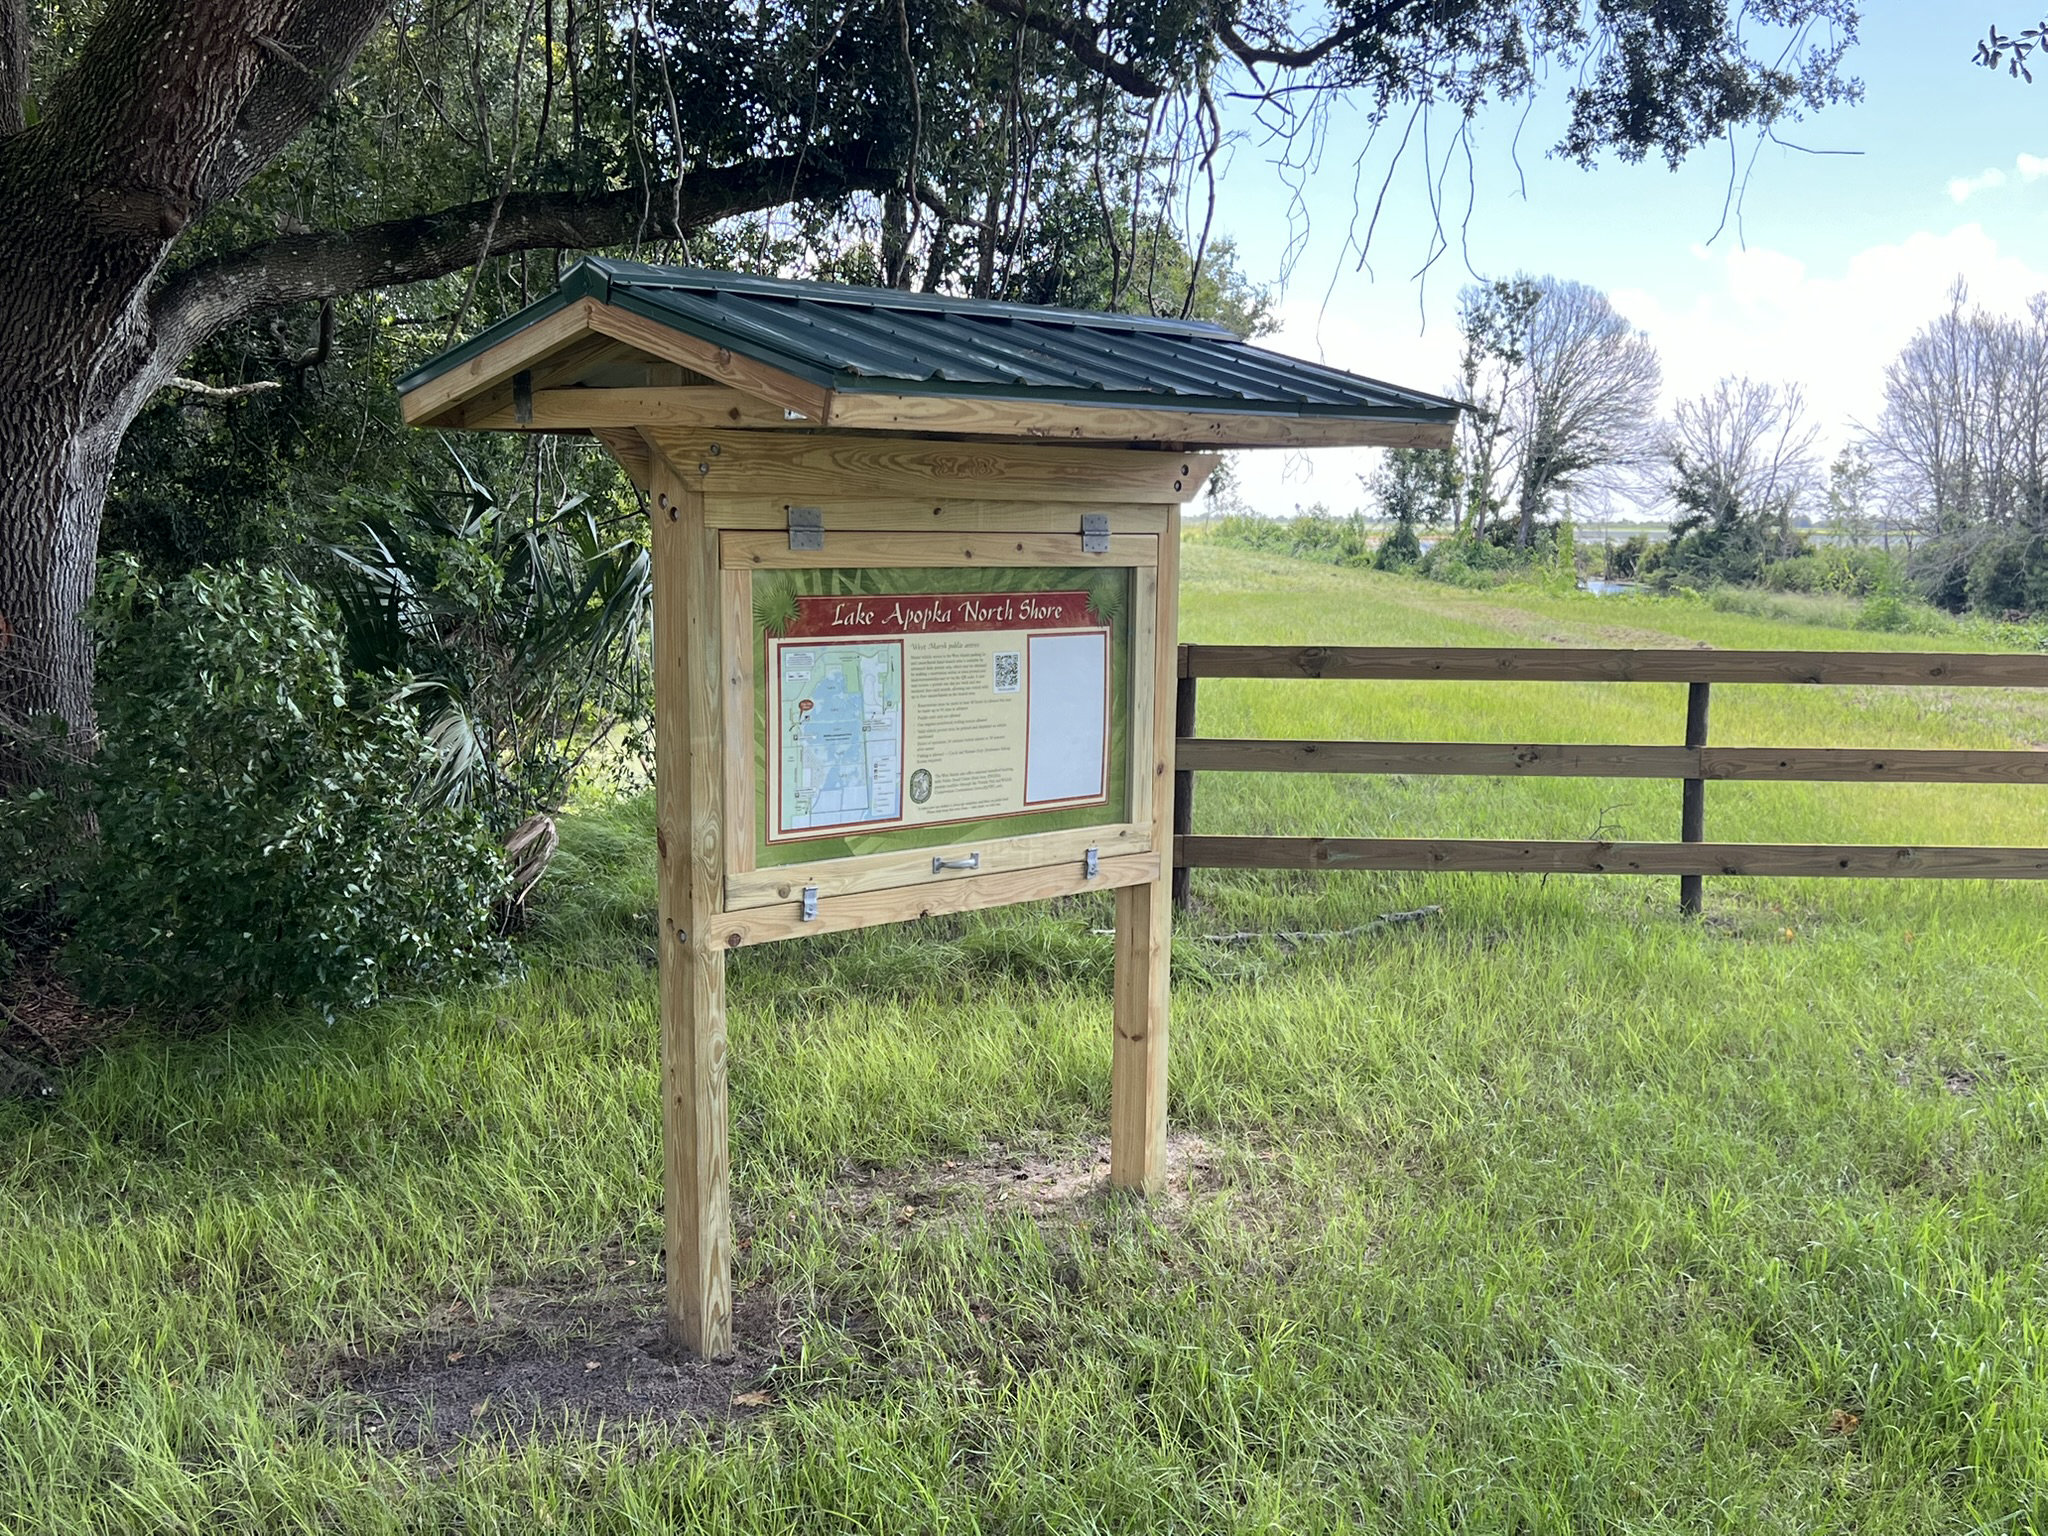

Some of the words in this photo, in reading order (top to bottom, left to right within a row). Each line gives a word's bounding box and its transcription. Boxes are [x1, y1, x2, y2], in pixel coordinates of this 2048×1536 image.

[831, 602, 875, 626] Lake
[881, 600, 951, 631] Apopka
[957, 598, 1013, 622] North
[1018, 597, 1063, 620] Shore
